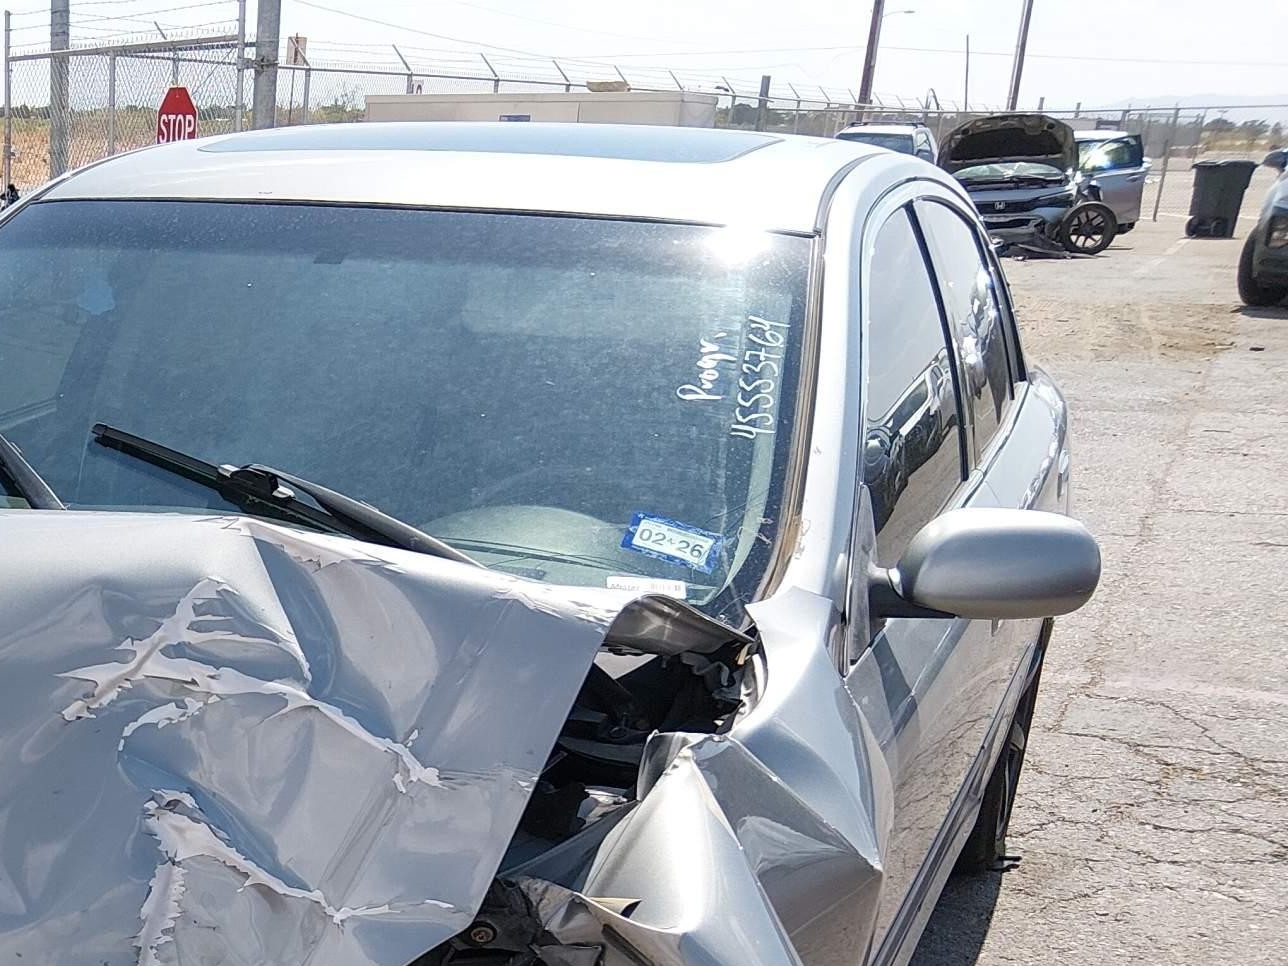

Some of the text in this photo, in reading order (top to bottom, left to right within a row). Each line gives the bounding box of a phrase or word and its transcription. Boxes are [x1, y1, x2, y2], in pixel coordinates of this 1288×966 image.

[158, 113, 195, 144] STOP
[729, 315, 791, 439] 45553764
[638, 528, 666, 546] 02
[676, 540, 705, 559] 26
